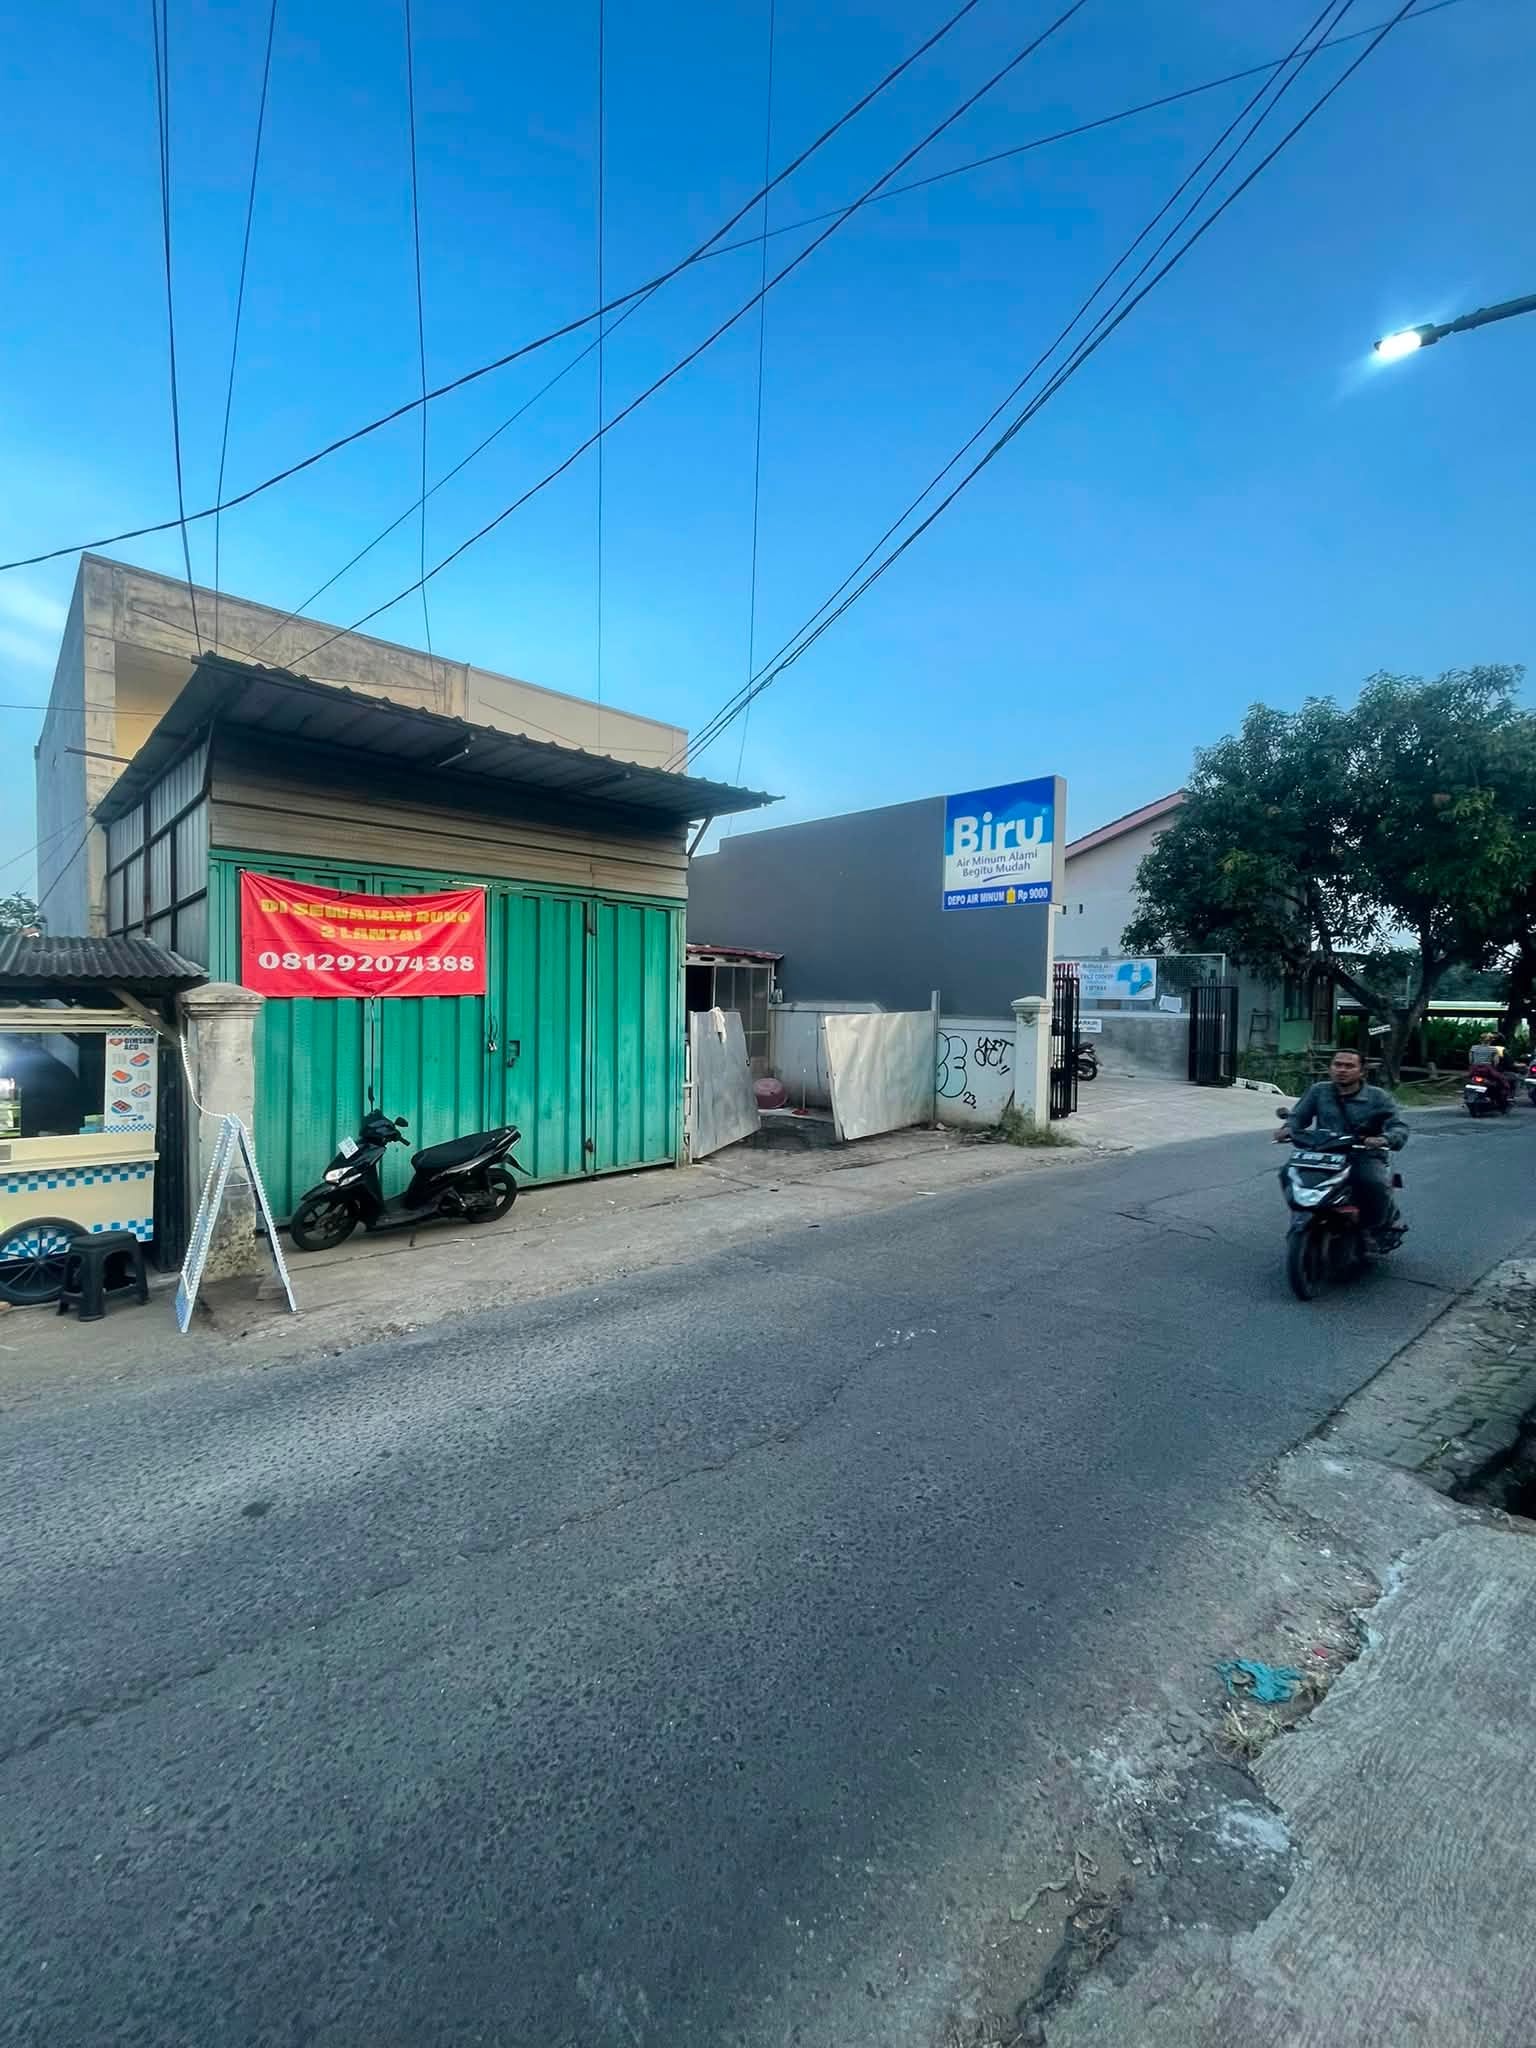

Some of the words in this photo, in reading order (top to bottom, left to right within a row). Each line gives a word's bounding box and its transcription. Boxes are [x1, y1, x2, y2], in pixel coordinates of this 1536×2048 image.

[953, 811, 1043, 855] Biru
[957, 859, 970, 868] Air
[972, 855, 1006, 866] Minum
[1009, 848, 1038, 861] Alami
[963, 866, 993, 878] Begitu
[996, 861, 1031, 873] Mudah
[947, 896, 966, 906] DEPO
[966, 894, 979, 904] AIR
[980, 891, 1005, 903] MINUM
[1017, 889, 1028, 902] Rp
[1029, 888, 1048, 899] 9000
[261, 898, 288, 915] DI
[290, 902, 413, 923] SEWAKAN
[339, 927, 424, 941] LANTAI
[258, 951, 475, 973] 081292074388
